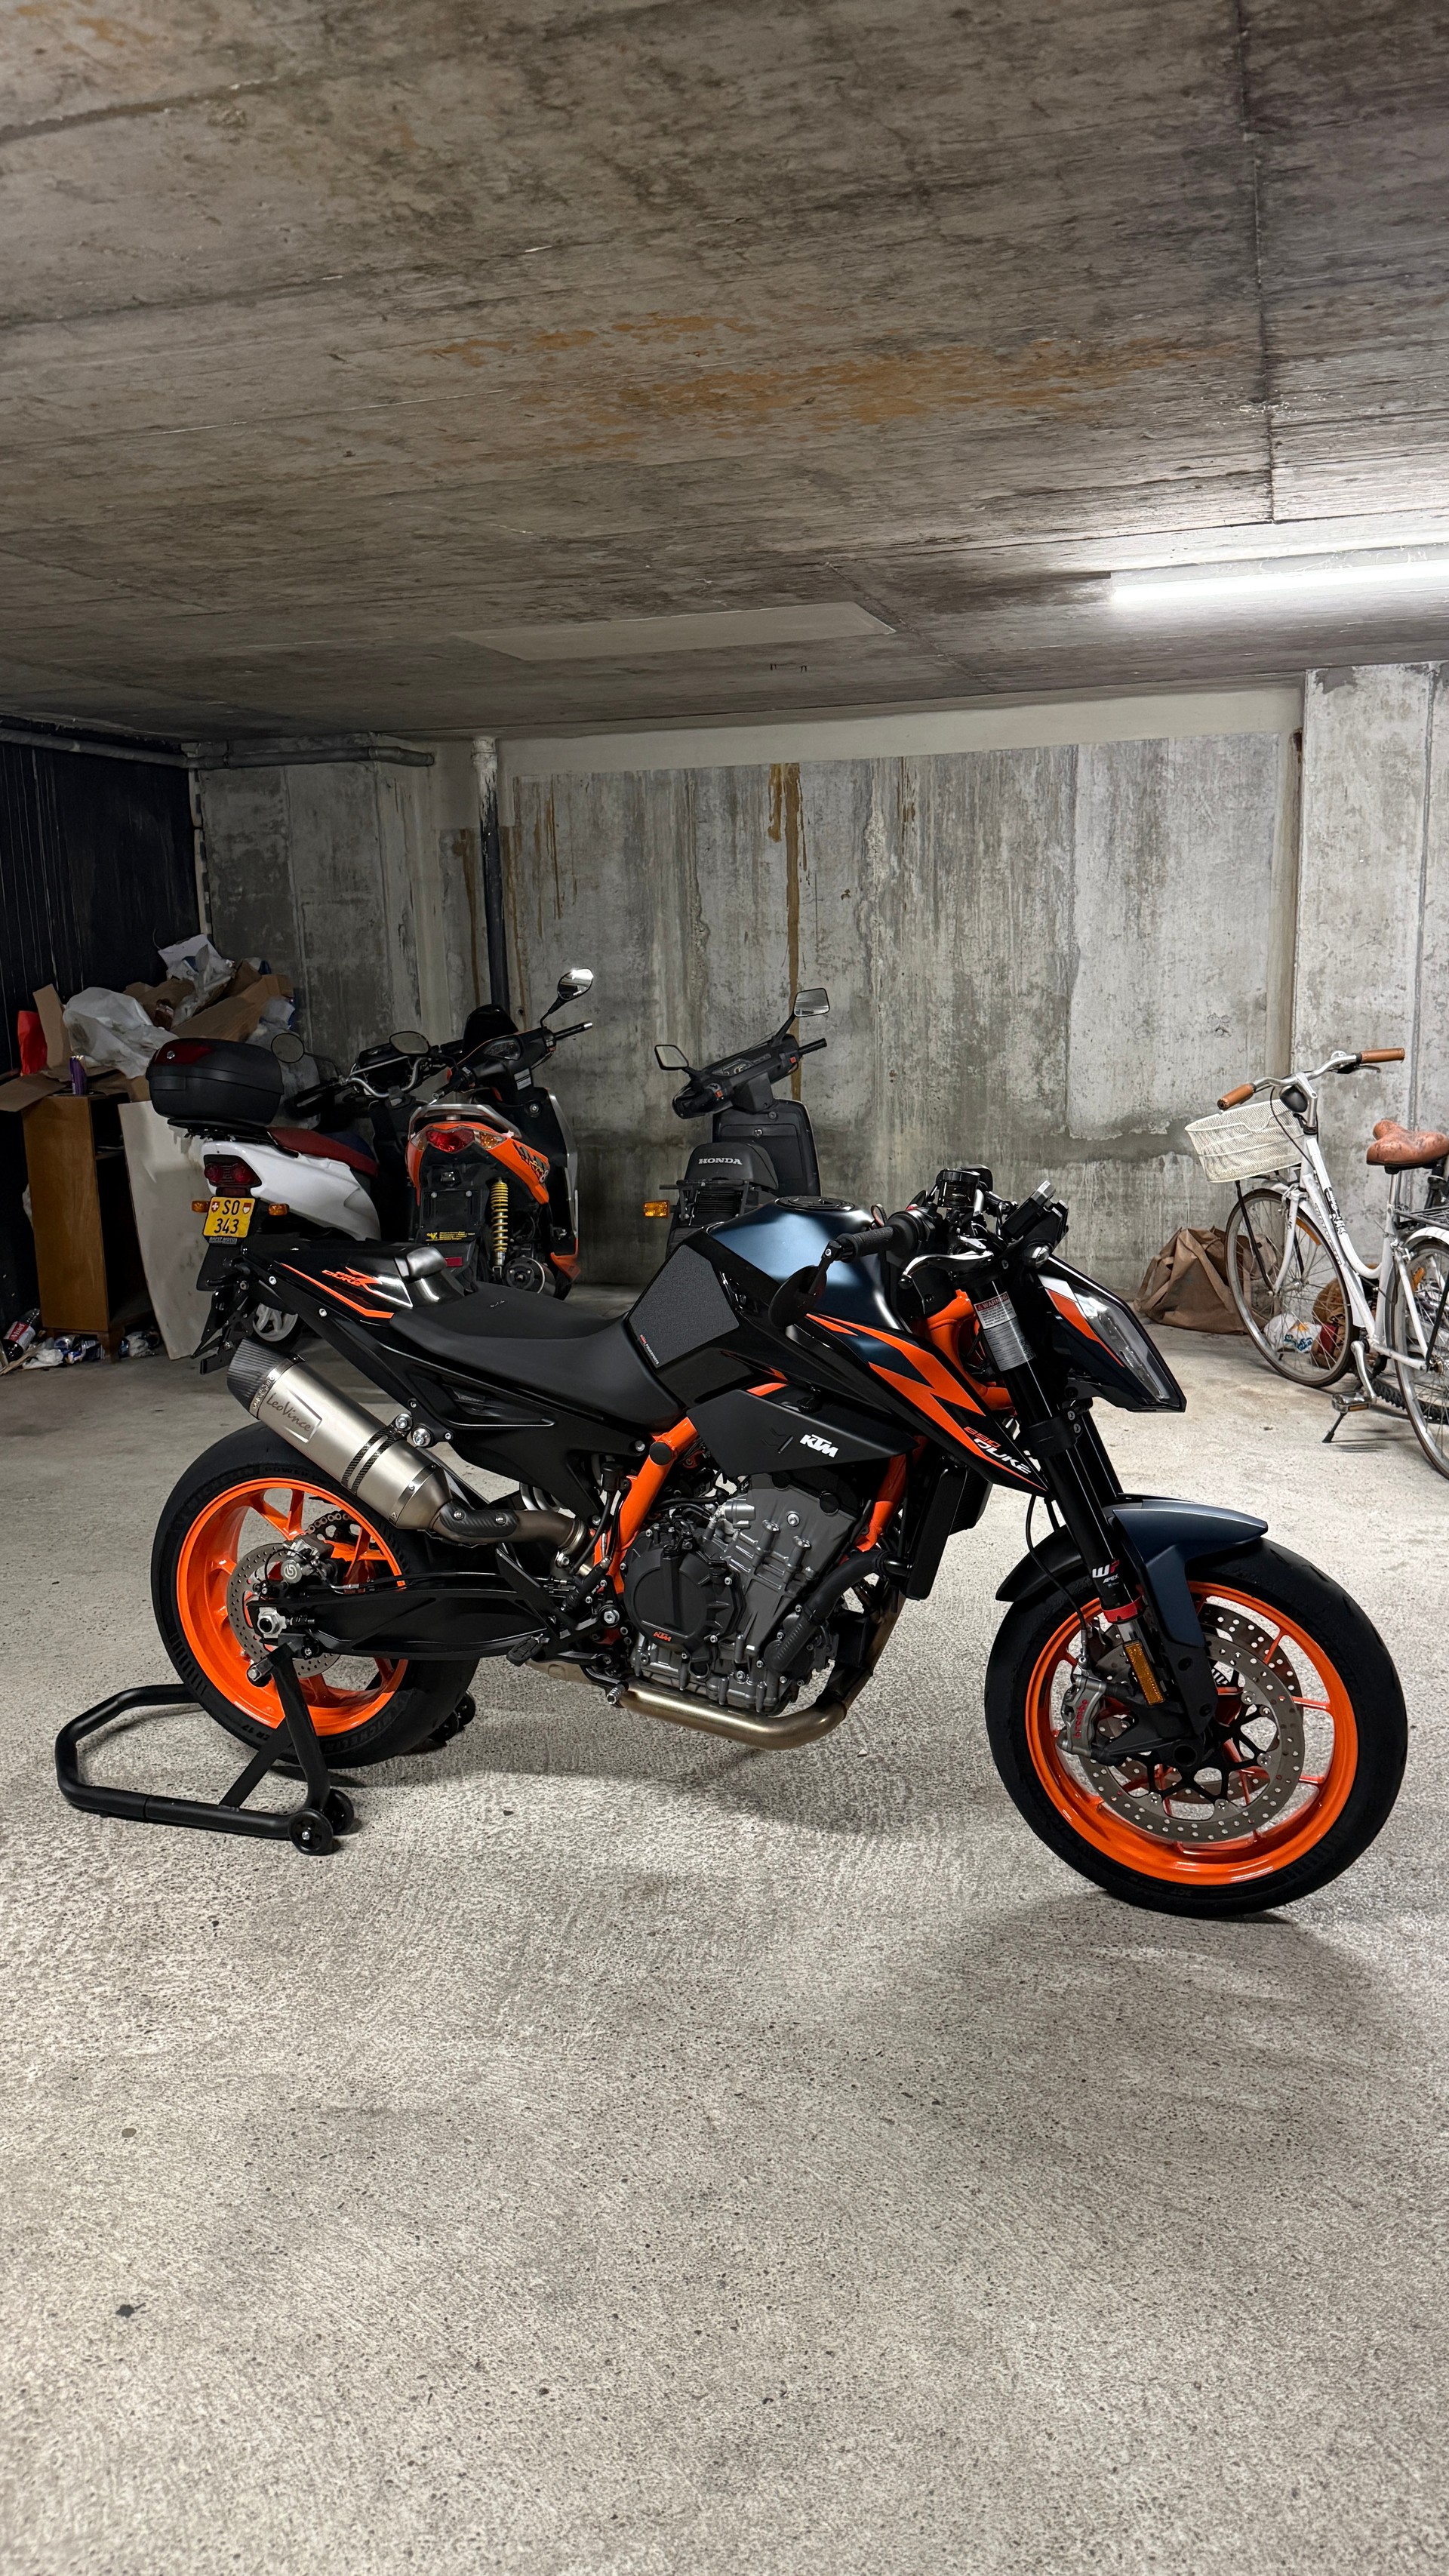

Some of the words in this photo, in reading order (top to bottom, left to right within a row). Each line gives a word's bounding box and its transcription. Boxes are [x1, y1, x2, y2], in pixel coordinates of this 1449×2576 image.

[698, 1157, 743, 1165] HONDA
[222, 1199, 240, 1215] SO
[214, 1217, 240, 1234] 343
[266, 1393, 312, 1432] LeoVince
[799, 1434, 839, 1458] KTM
[964, 1426, 1001, 1448] 890
[974, 1438, 1032, 1475] DUKE
[1092, 1559, 1120, 1578] WP
[653, 1631, 672, 1642] KTM
[240, 1722, 255, 1734] 17
[1074, 1699, 1088, 1738] brembo
